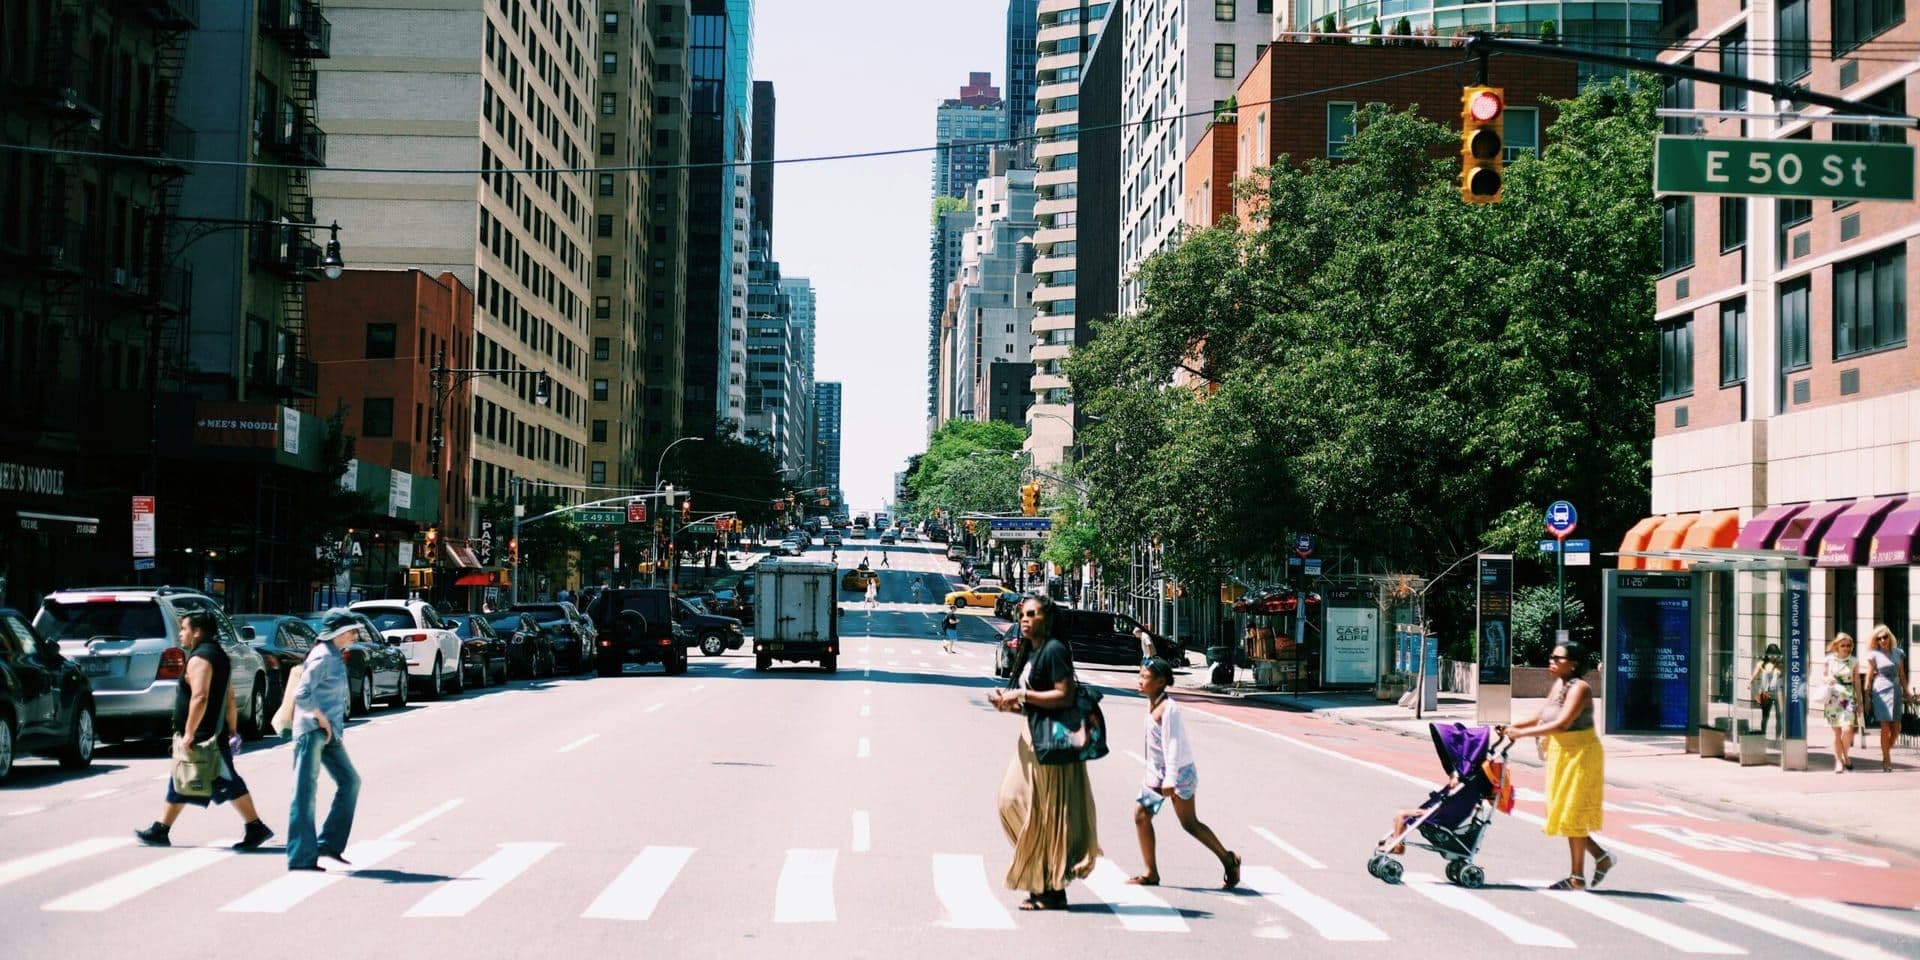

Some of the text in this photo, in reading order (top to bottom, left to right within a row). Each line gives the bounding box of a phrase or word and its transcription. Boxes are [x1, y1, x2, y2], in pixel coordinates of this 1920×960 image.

[1706, 150, 1866, 187] E 50 St
[207, 419, 237, 429] MEE'S
[26, 465, 64, 496] NOODLE
[583, 513, 588, 521] E
[605, 514, 615, 522] St
[482, 522, 492, 556] PARK
[1791, 592, 1800, 627] Avenue
[1336, 627, 1369, 635] CASH
[1791, 628, 1800, 636] &
[1791, 638, 1800, 659] East
[1791, 661, 1800, 673] 50
[1791, 675, 1800, 703] Street
